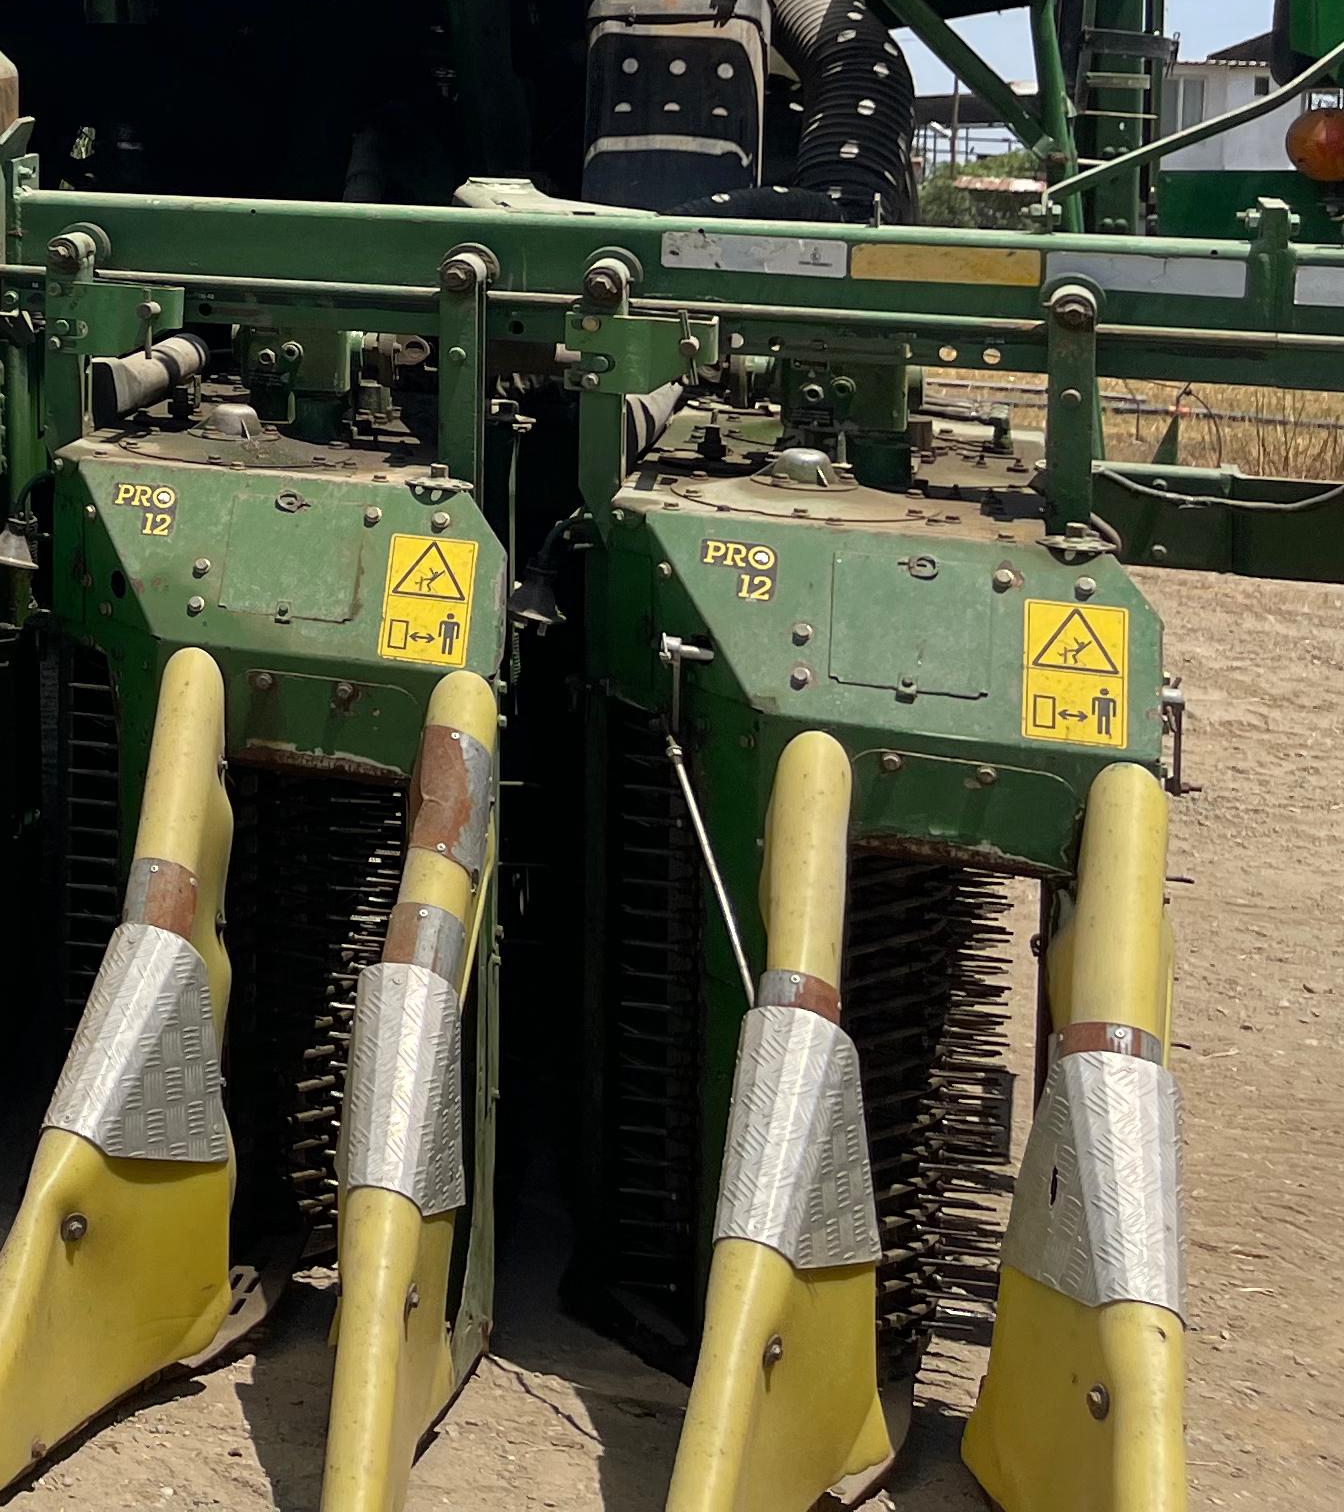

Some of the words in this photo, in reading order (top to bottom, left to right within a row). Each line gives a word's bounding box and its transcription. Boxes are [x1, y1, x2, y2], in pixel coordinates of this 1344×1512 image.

[113, 484, 176, 509] PRO
[142, 512, 172, 536] 12
[703, 540, 775, 570] PRO
[738, 574, 772, 601] 12
